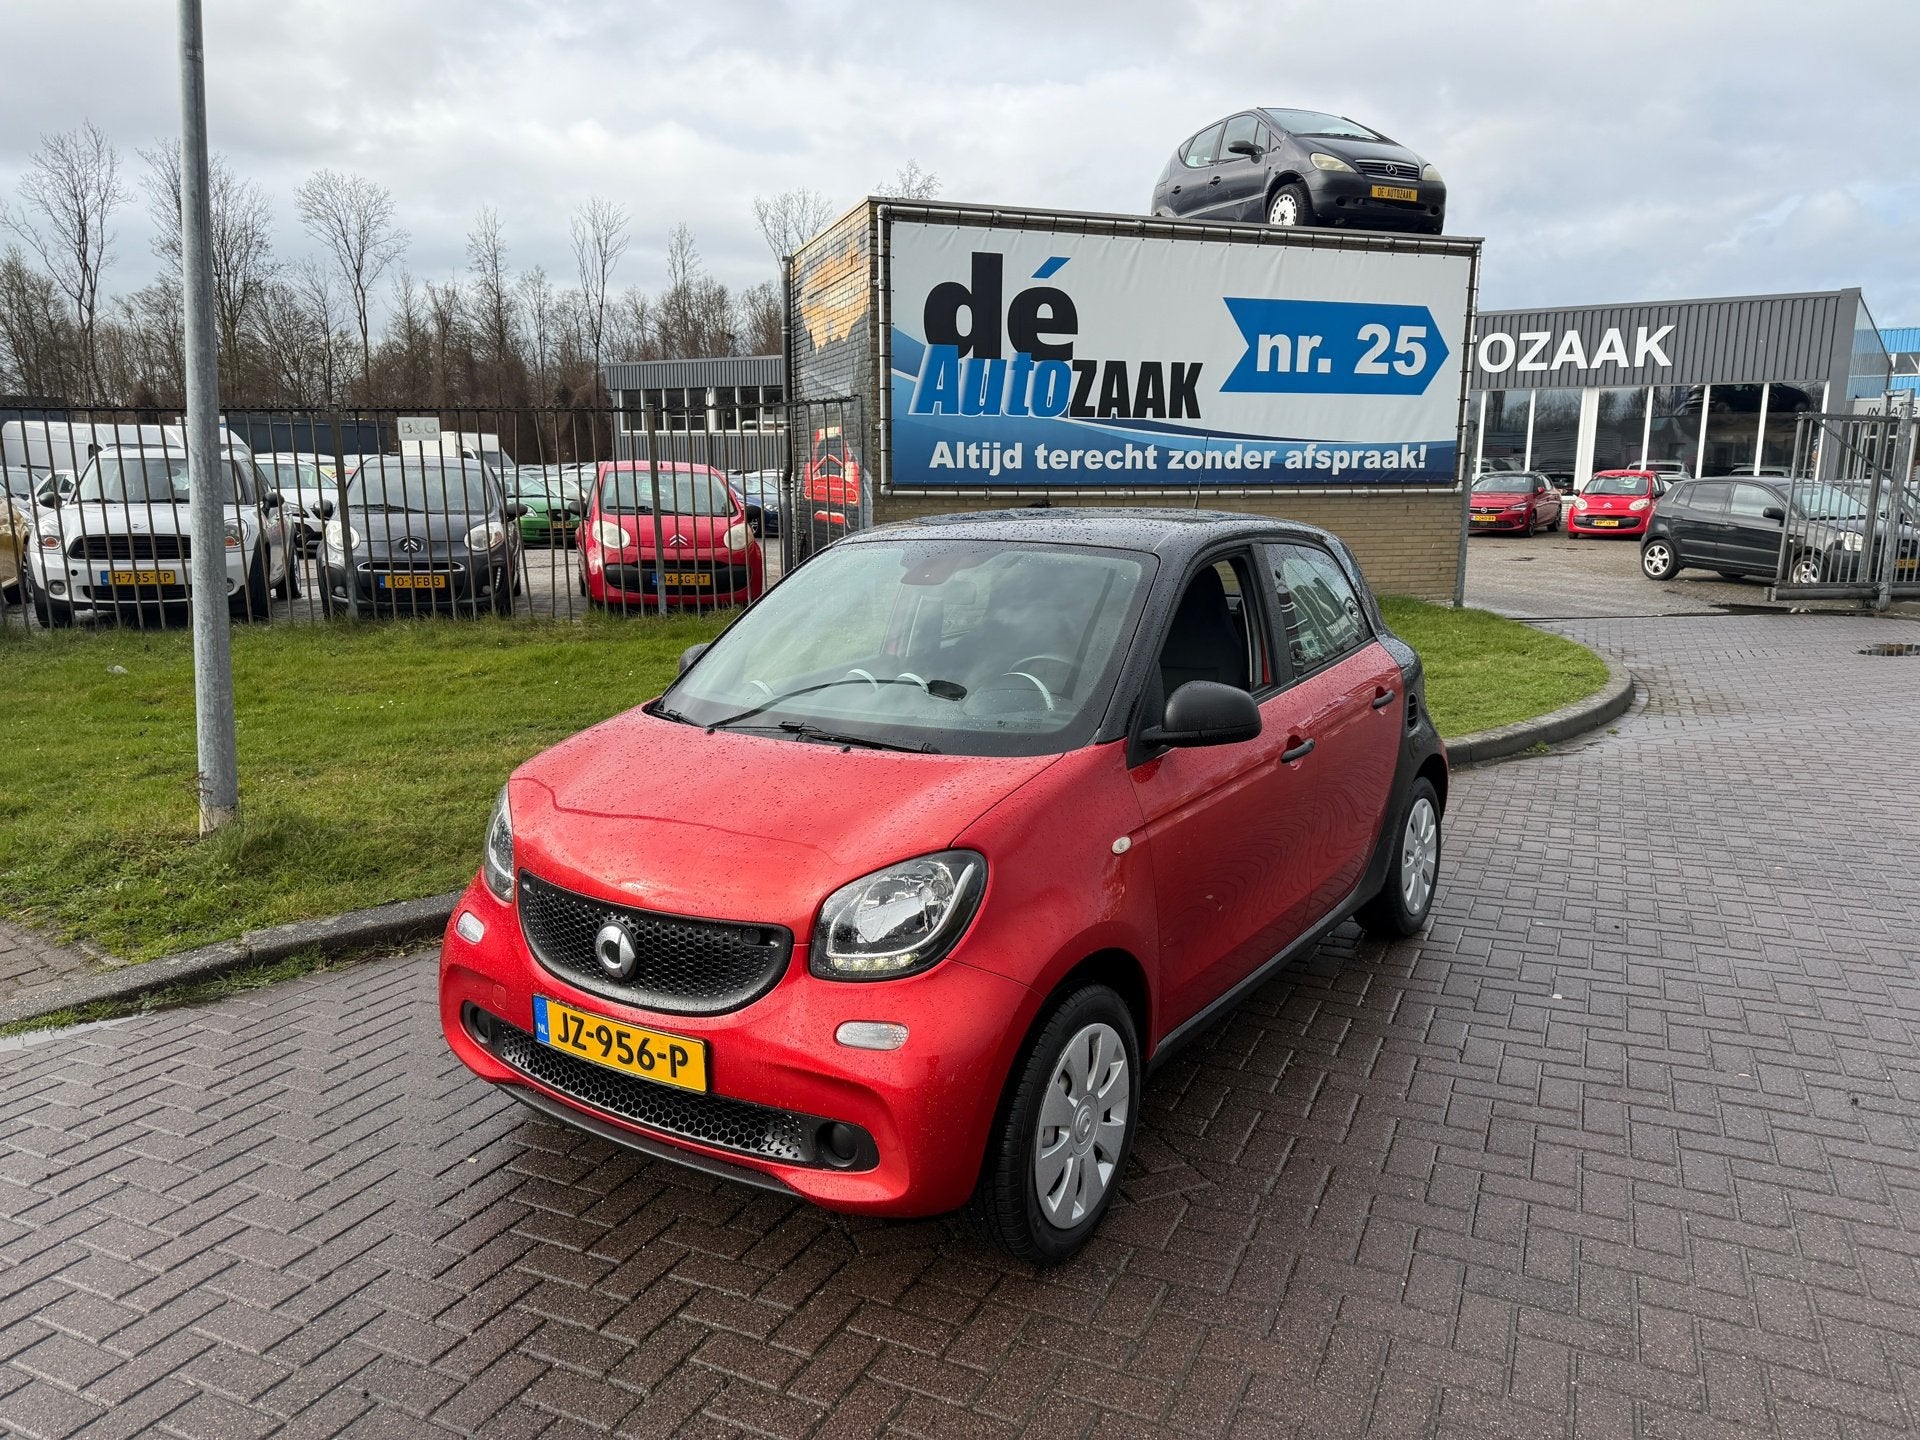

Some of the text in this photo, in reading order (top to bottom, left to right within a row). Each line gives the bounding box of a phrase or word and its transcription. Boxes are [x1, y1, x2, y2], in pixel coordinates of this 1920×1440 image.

[924, 251, 1079, 362] dé
[1256, 323, 1427, 376] nr. 25
[1474, 325, 1676, 373] OZAAK
[401, 420, 438, 435] B&G
[1867, 406, 1919, 416] INAG
[929, 441, 1428, 476] Altijd terecht zonder afspraak!
[387, 576, 441, 587] 0-XFB3
[664, 574, 707, 584] 4-SG-RT
[537, 1012, 689, 1078] NL JZ-956-P
